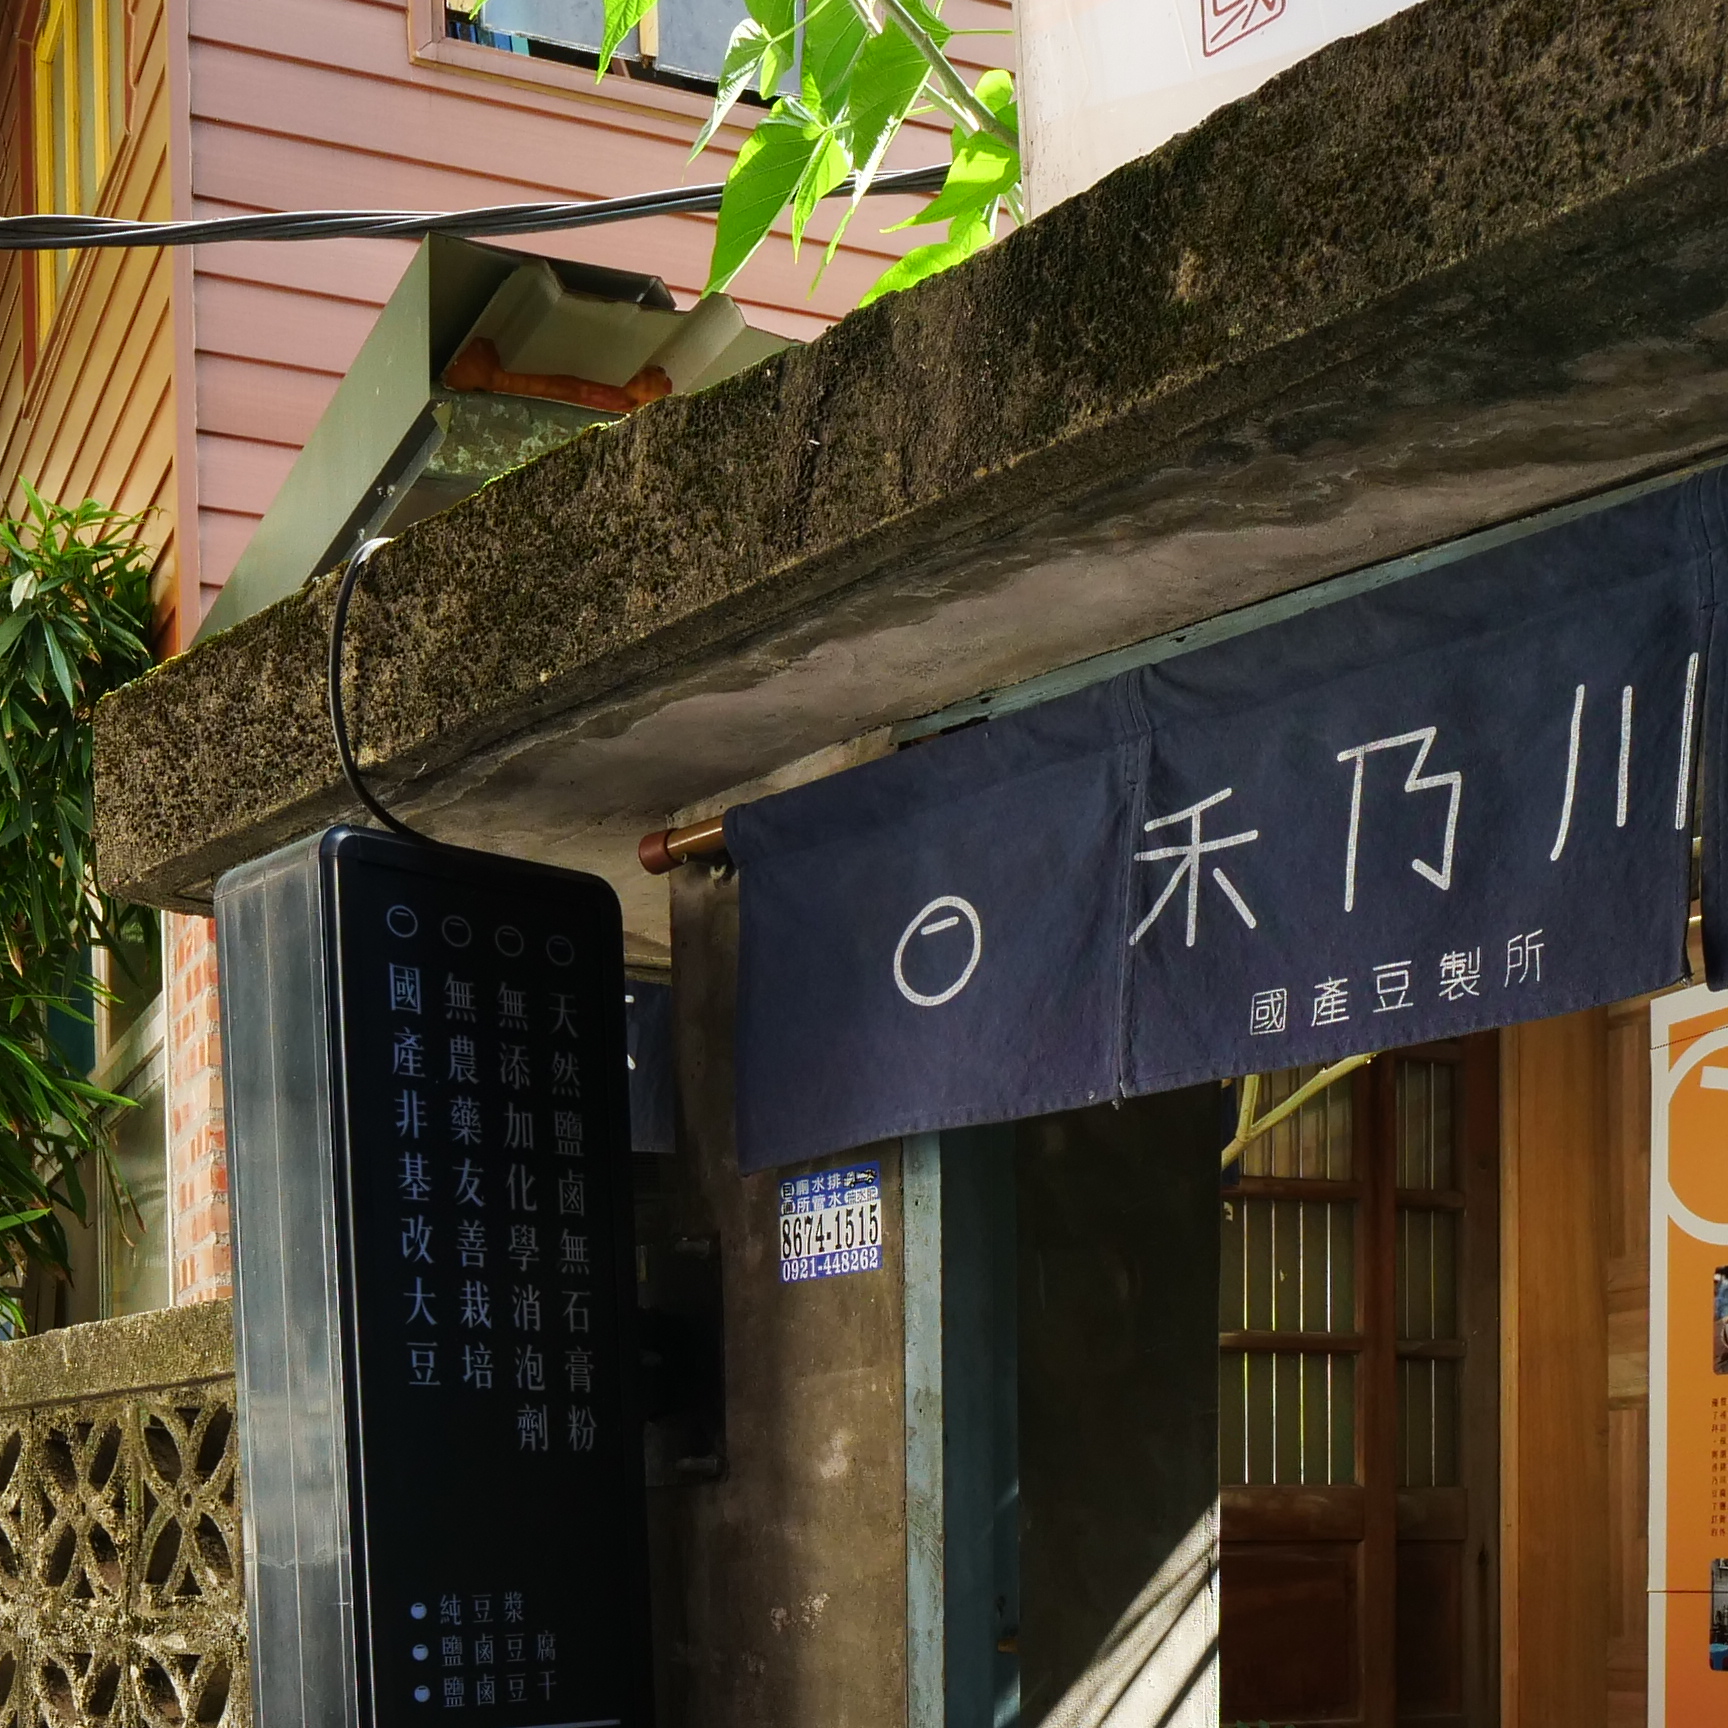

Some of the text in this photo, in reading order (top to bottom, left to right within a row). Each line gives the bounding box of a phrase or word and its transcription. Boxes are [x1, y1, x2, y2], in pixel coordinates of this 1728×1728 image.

[1129, 651, 1699, 947] 禾乃川
[1249, 928, 1545, 1036] 國產豆製所
[387, 961, 441, 1387] 國產非基改大豆
[443, 972, 494, 1390] 無農藥友善栽培
[495, 981, 550, 1452] 無添加化學消泡劑
[782, 1203, 879, 1259] 8674-1515
[782, 1247, 878, 1282] 0921-448262
[439, 1590, 525, 1626] 純豆漿
[441, 1629, 557, 1667] 鹽鹵豆腐
[443, 1670, 558, 1708] 鹽鹵豆干
